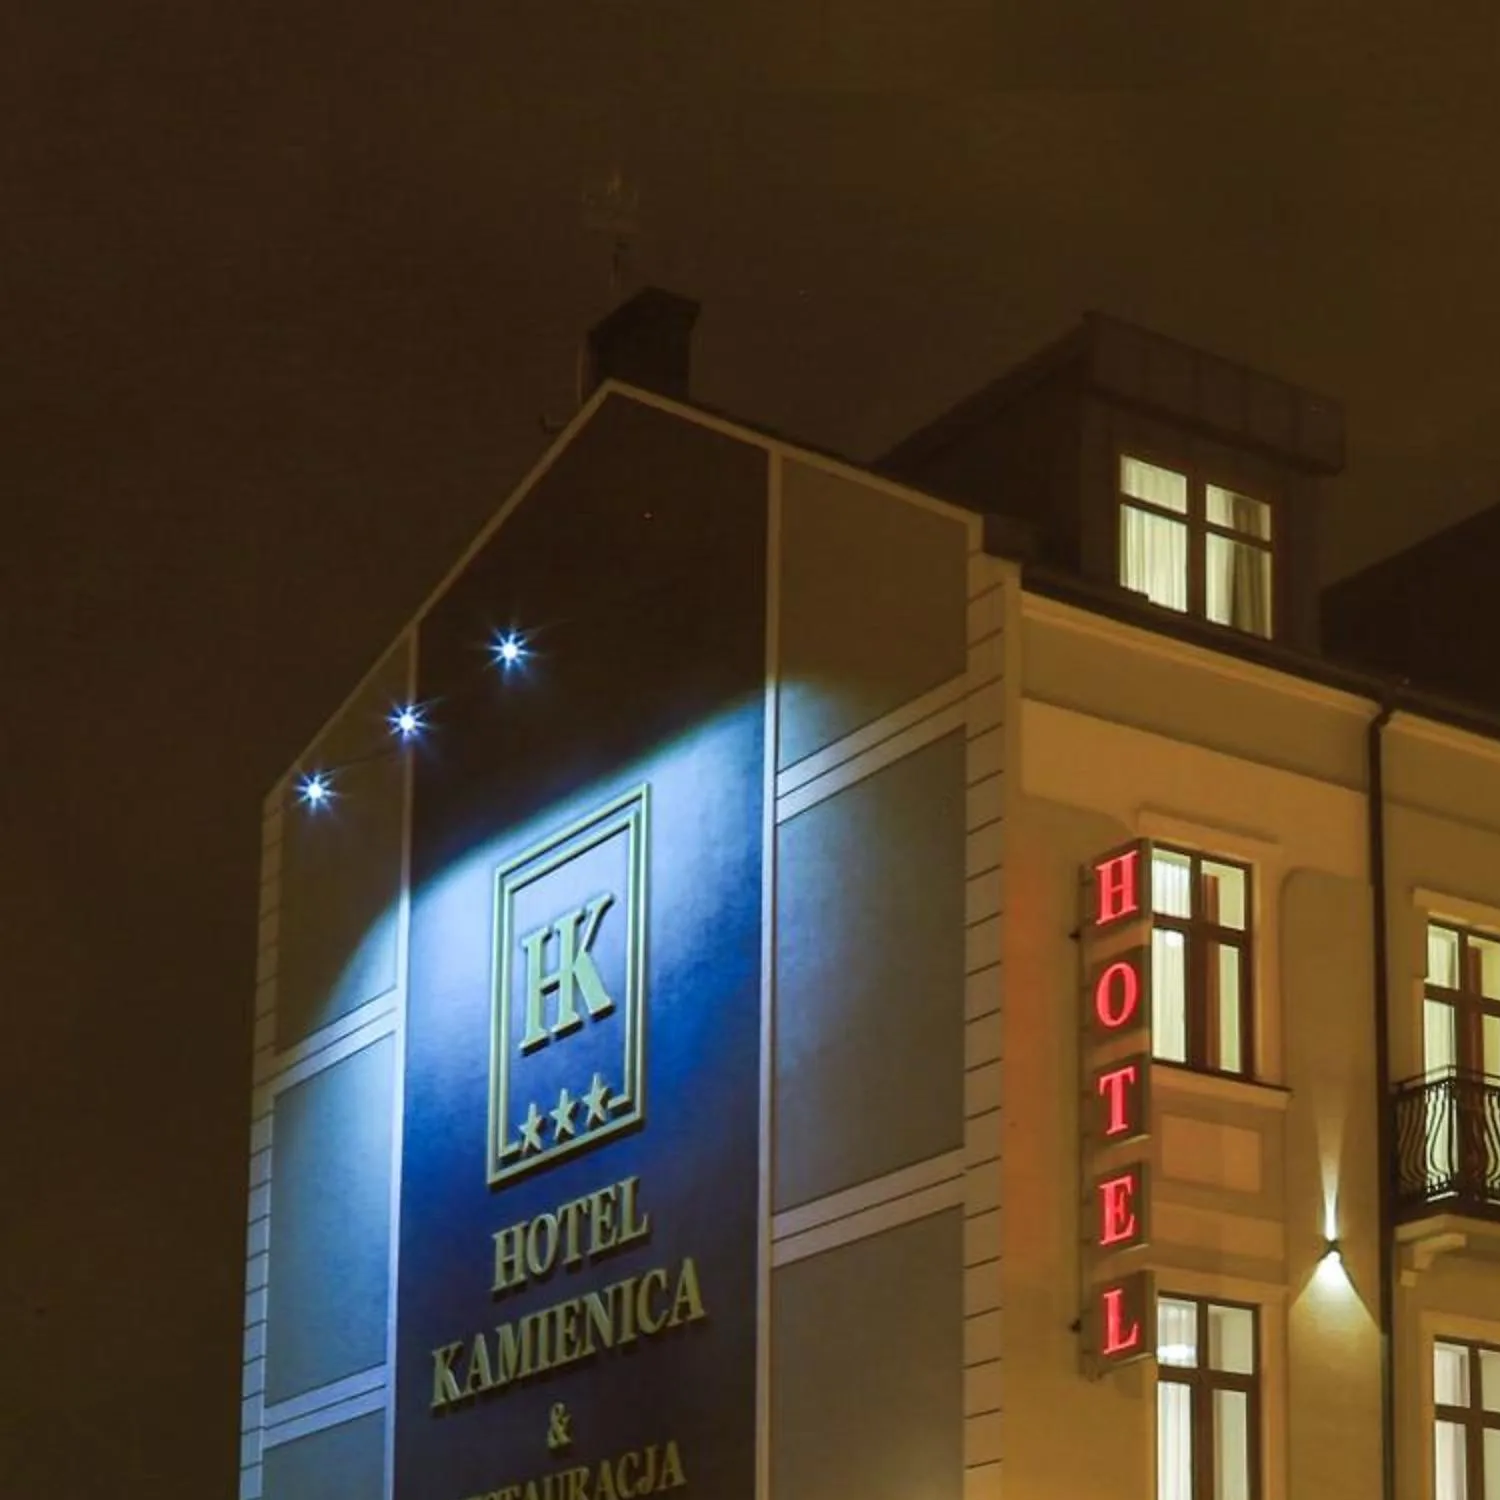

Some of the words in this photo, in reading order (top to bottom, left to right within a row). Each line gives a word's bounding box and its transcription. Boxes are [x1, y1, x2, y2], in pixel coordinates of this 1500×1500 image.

[518, 893, 616, 1053] HK
[1094, 849, 1140, 1356] HOTEL
[490, 1176, 650, 1293] HOTEL
[430, 1257, 708, 1408] KAMIENICA
[546, 1402, 574, 1450] &
